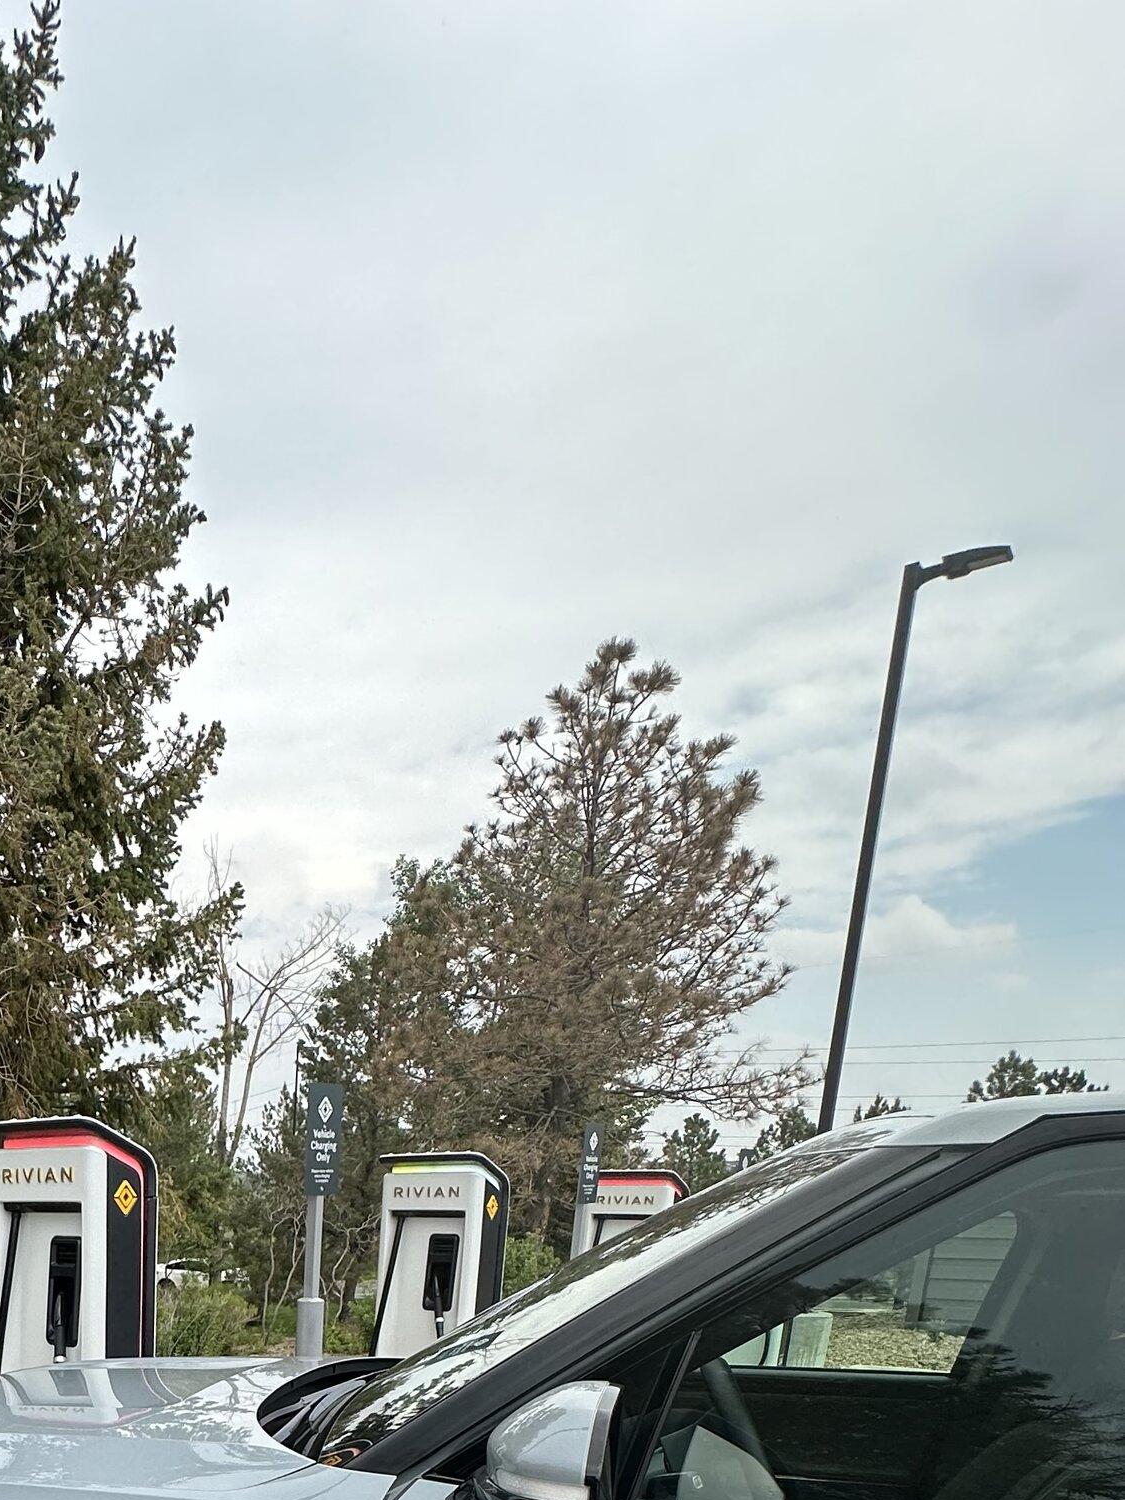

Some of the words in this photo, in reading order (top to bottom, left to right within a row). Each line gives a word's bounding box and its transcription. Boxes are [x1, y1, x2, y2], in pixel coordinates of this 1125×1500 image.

[313, 1128, 336, 1139] Vehicle
[310, 1140, 338, 1153] Charging
[316, 1151, 331, 1164] Only
[2, 1166, 74, 1184] RIVIAN
[393, 1185, 461, 1198] RIVIAN
[596, 1195, 655, 1205] RIVIAN
